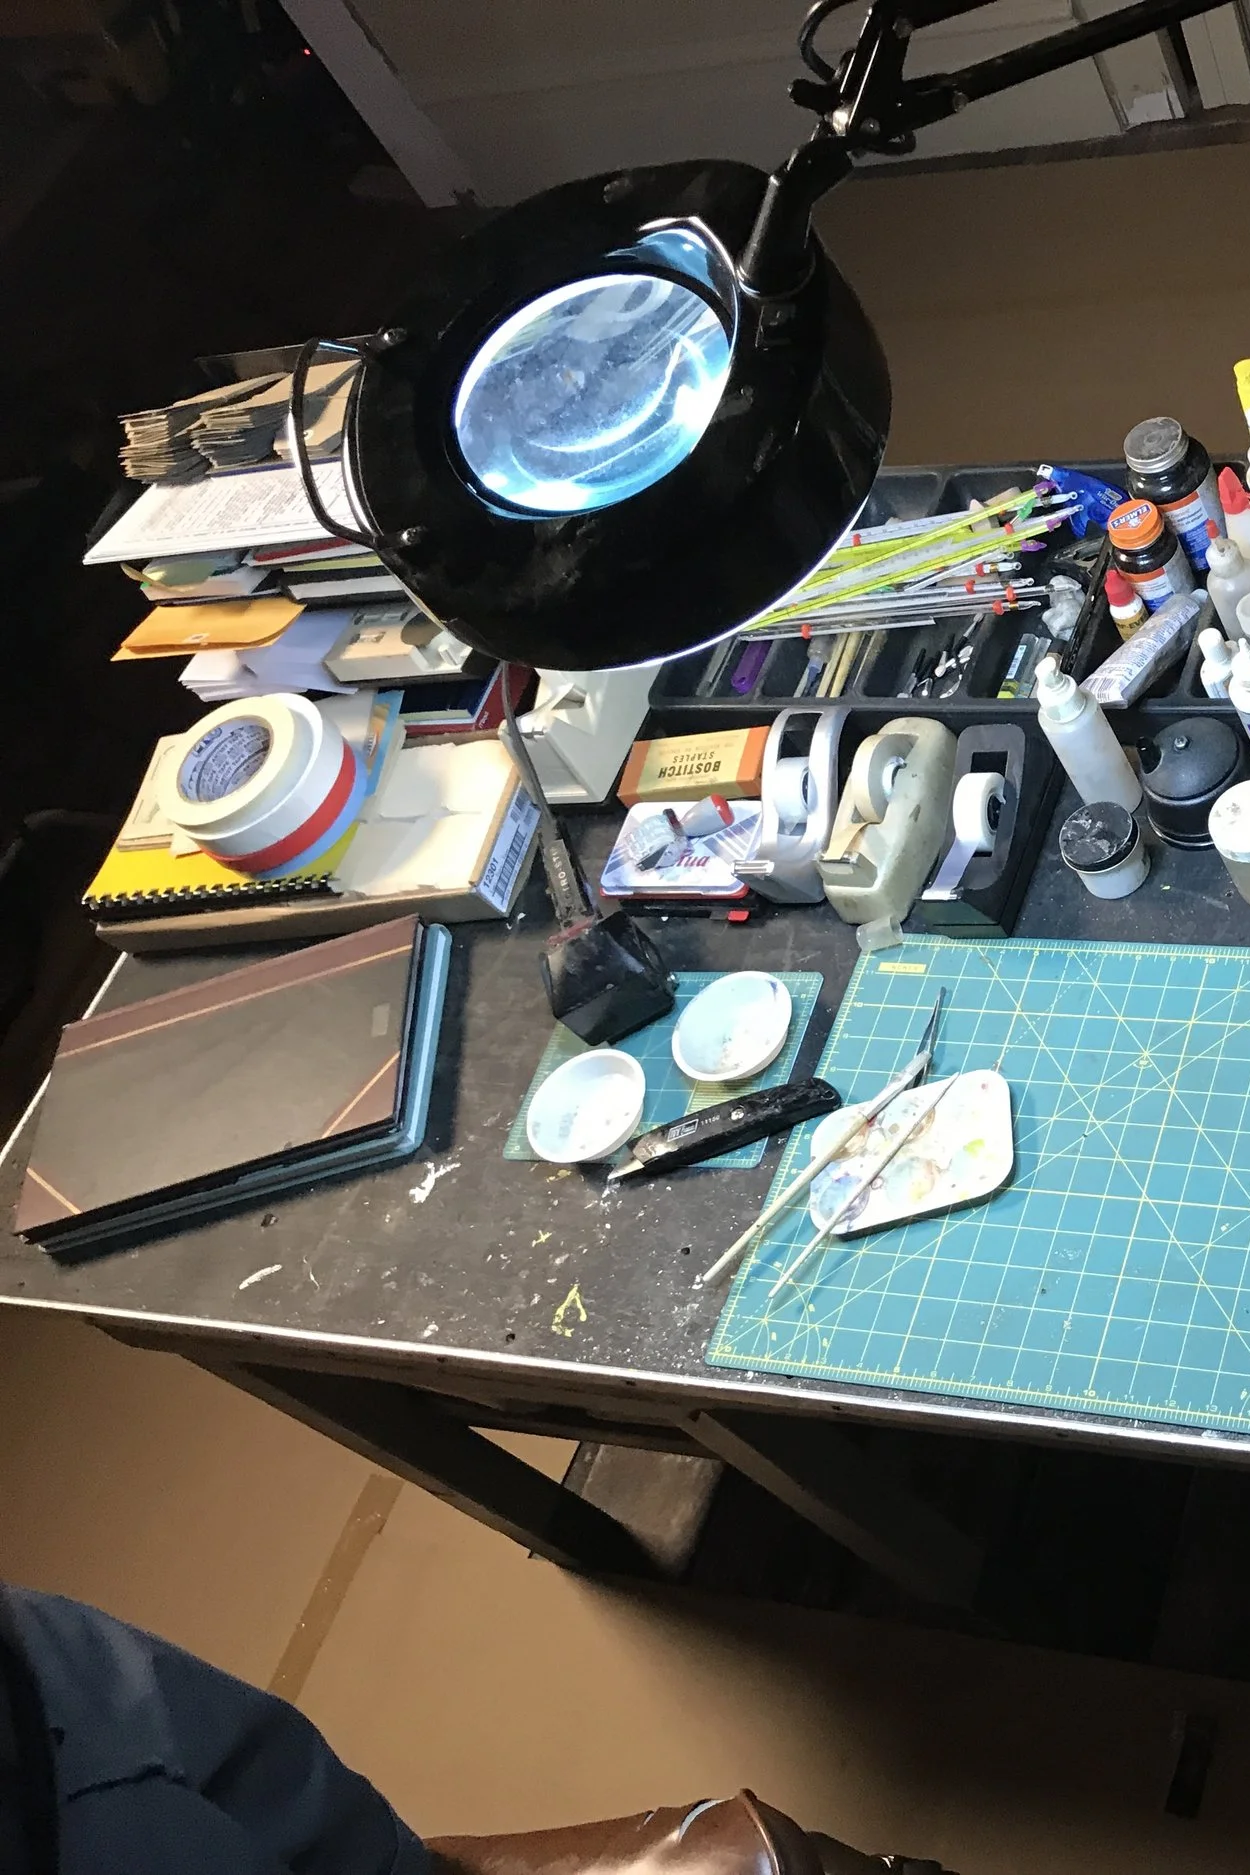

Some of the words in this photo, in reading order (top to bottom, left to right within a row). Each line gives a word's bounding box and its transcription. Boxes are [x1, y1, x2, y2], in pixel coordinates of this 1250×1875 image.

[673, 751, 715, 763] STAPLES
[658, 760, 722, 779] BOSTITCH
[482, 857, 499, 889] 12301
